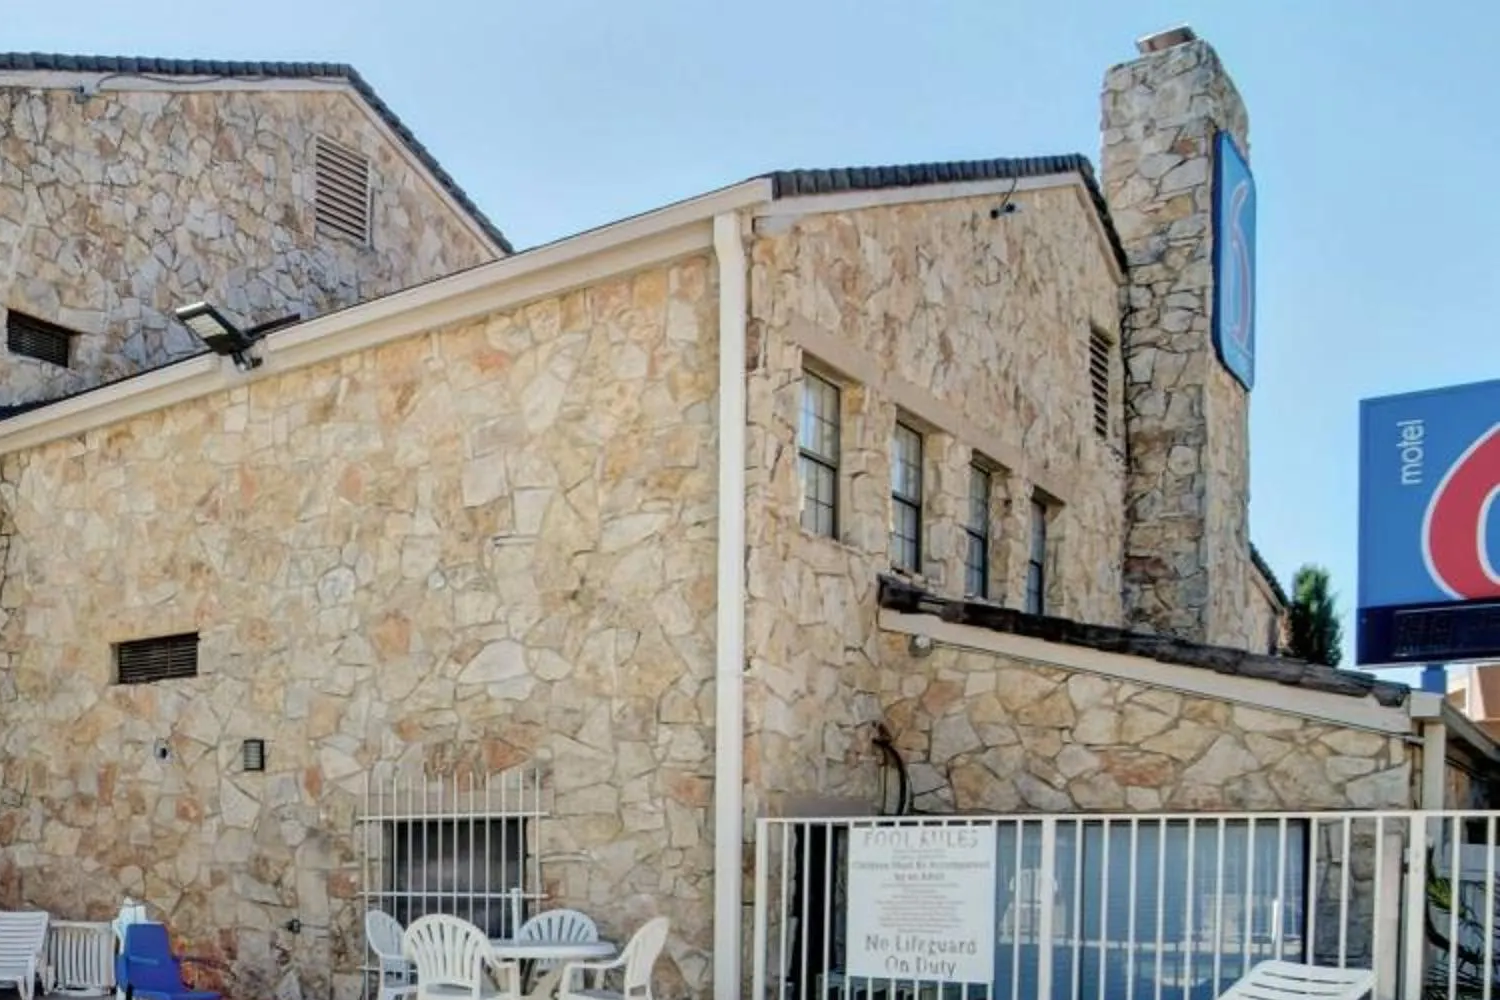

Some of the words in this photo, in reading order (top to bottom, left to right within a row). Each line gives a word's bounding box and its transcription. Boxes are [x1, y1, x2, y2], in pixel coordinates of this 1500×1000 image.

[1396, 419, 1425, 485] motel
[865, 934, 889, 952] No
[895, 935, 977, 956] Lifeguard
[885, 955, 909, 973] On
[916, 956, 957, 978] Duty
